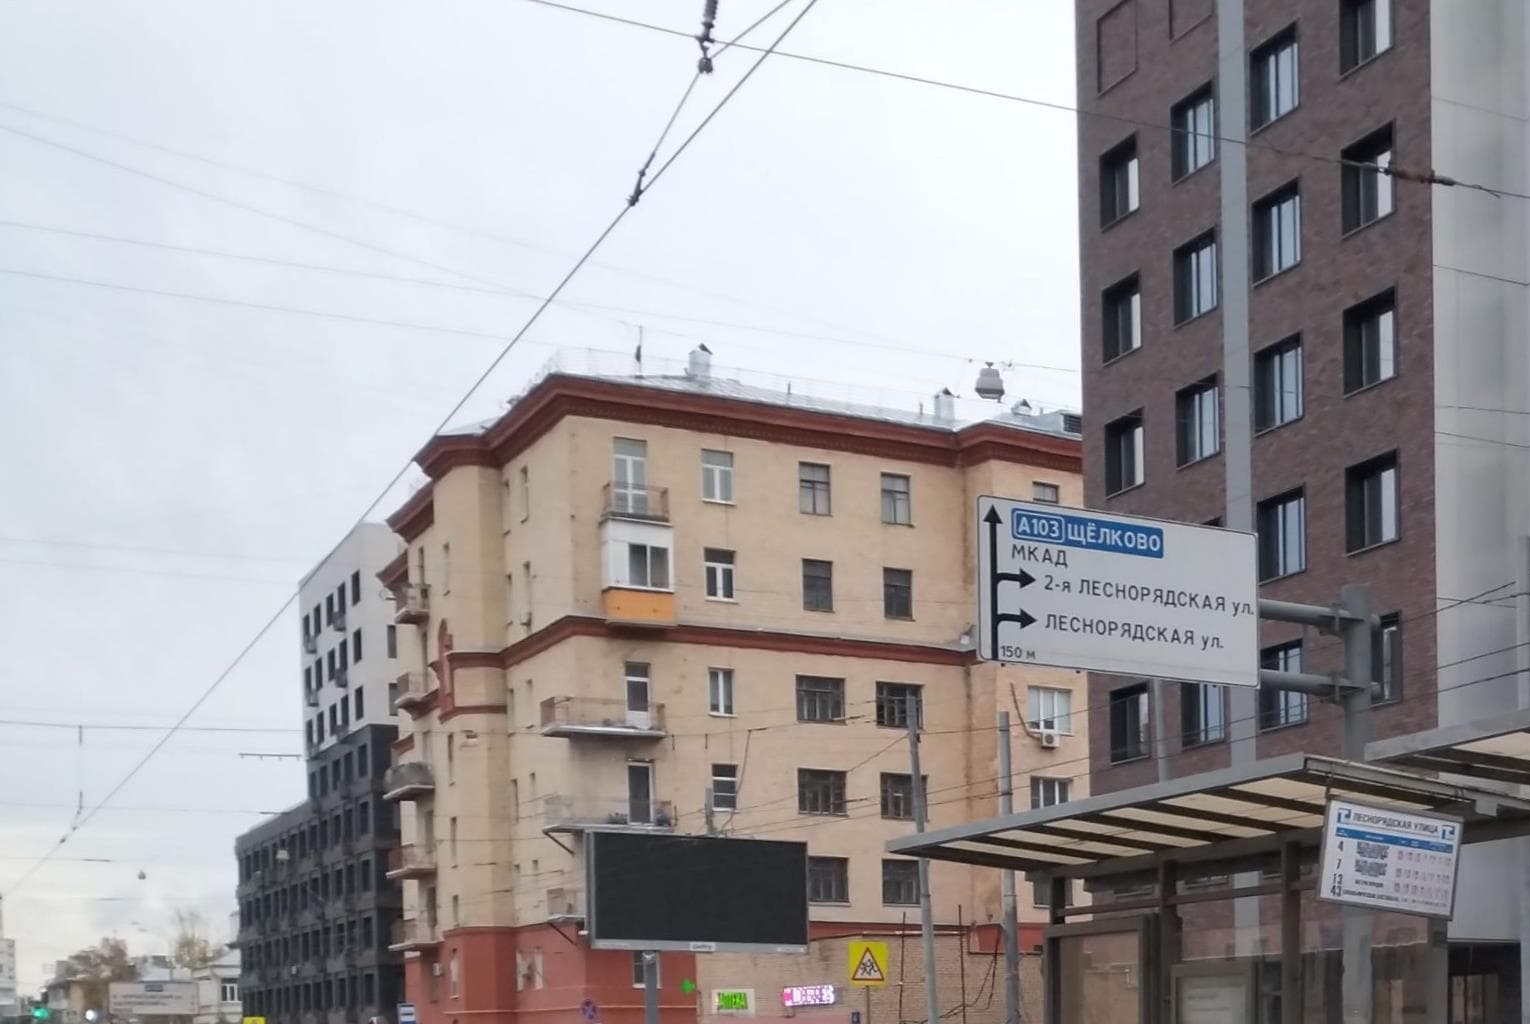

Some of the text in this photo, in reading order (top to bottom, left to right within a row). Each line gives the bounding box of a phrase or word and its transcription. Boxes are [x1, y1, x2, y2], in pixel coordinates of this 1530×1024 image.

[1067, 521, 1161, 552] ЩЁЛКОВО
[1011, 543, 1068, 568] МКАД
[1044, 575, 1254, 616] 2-я ЛЕСНОРЯДСКАЯ ул.
[1045, 614, 1224, 650] ЛЕСНОРЯДСКАЯ ул.
[1000, 645, 1035, 660] 150 м
